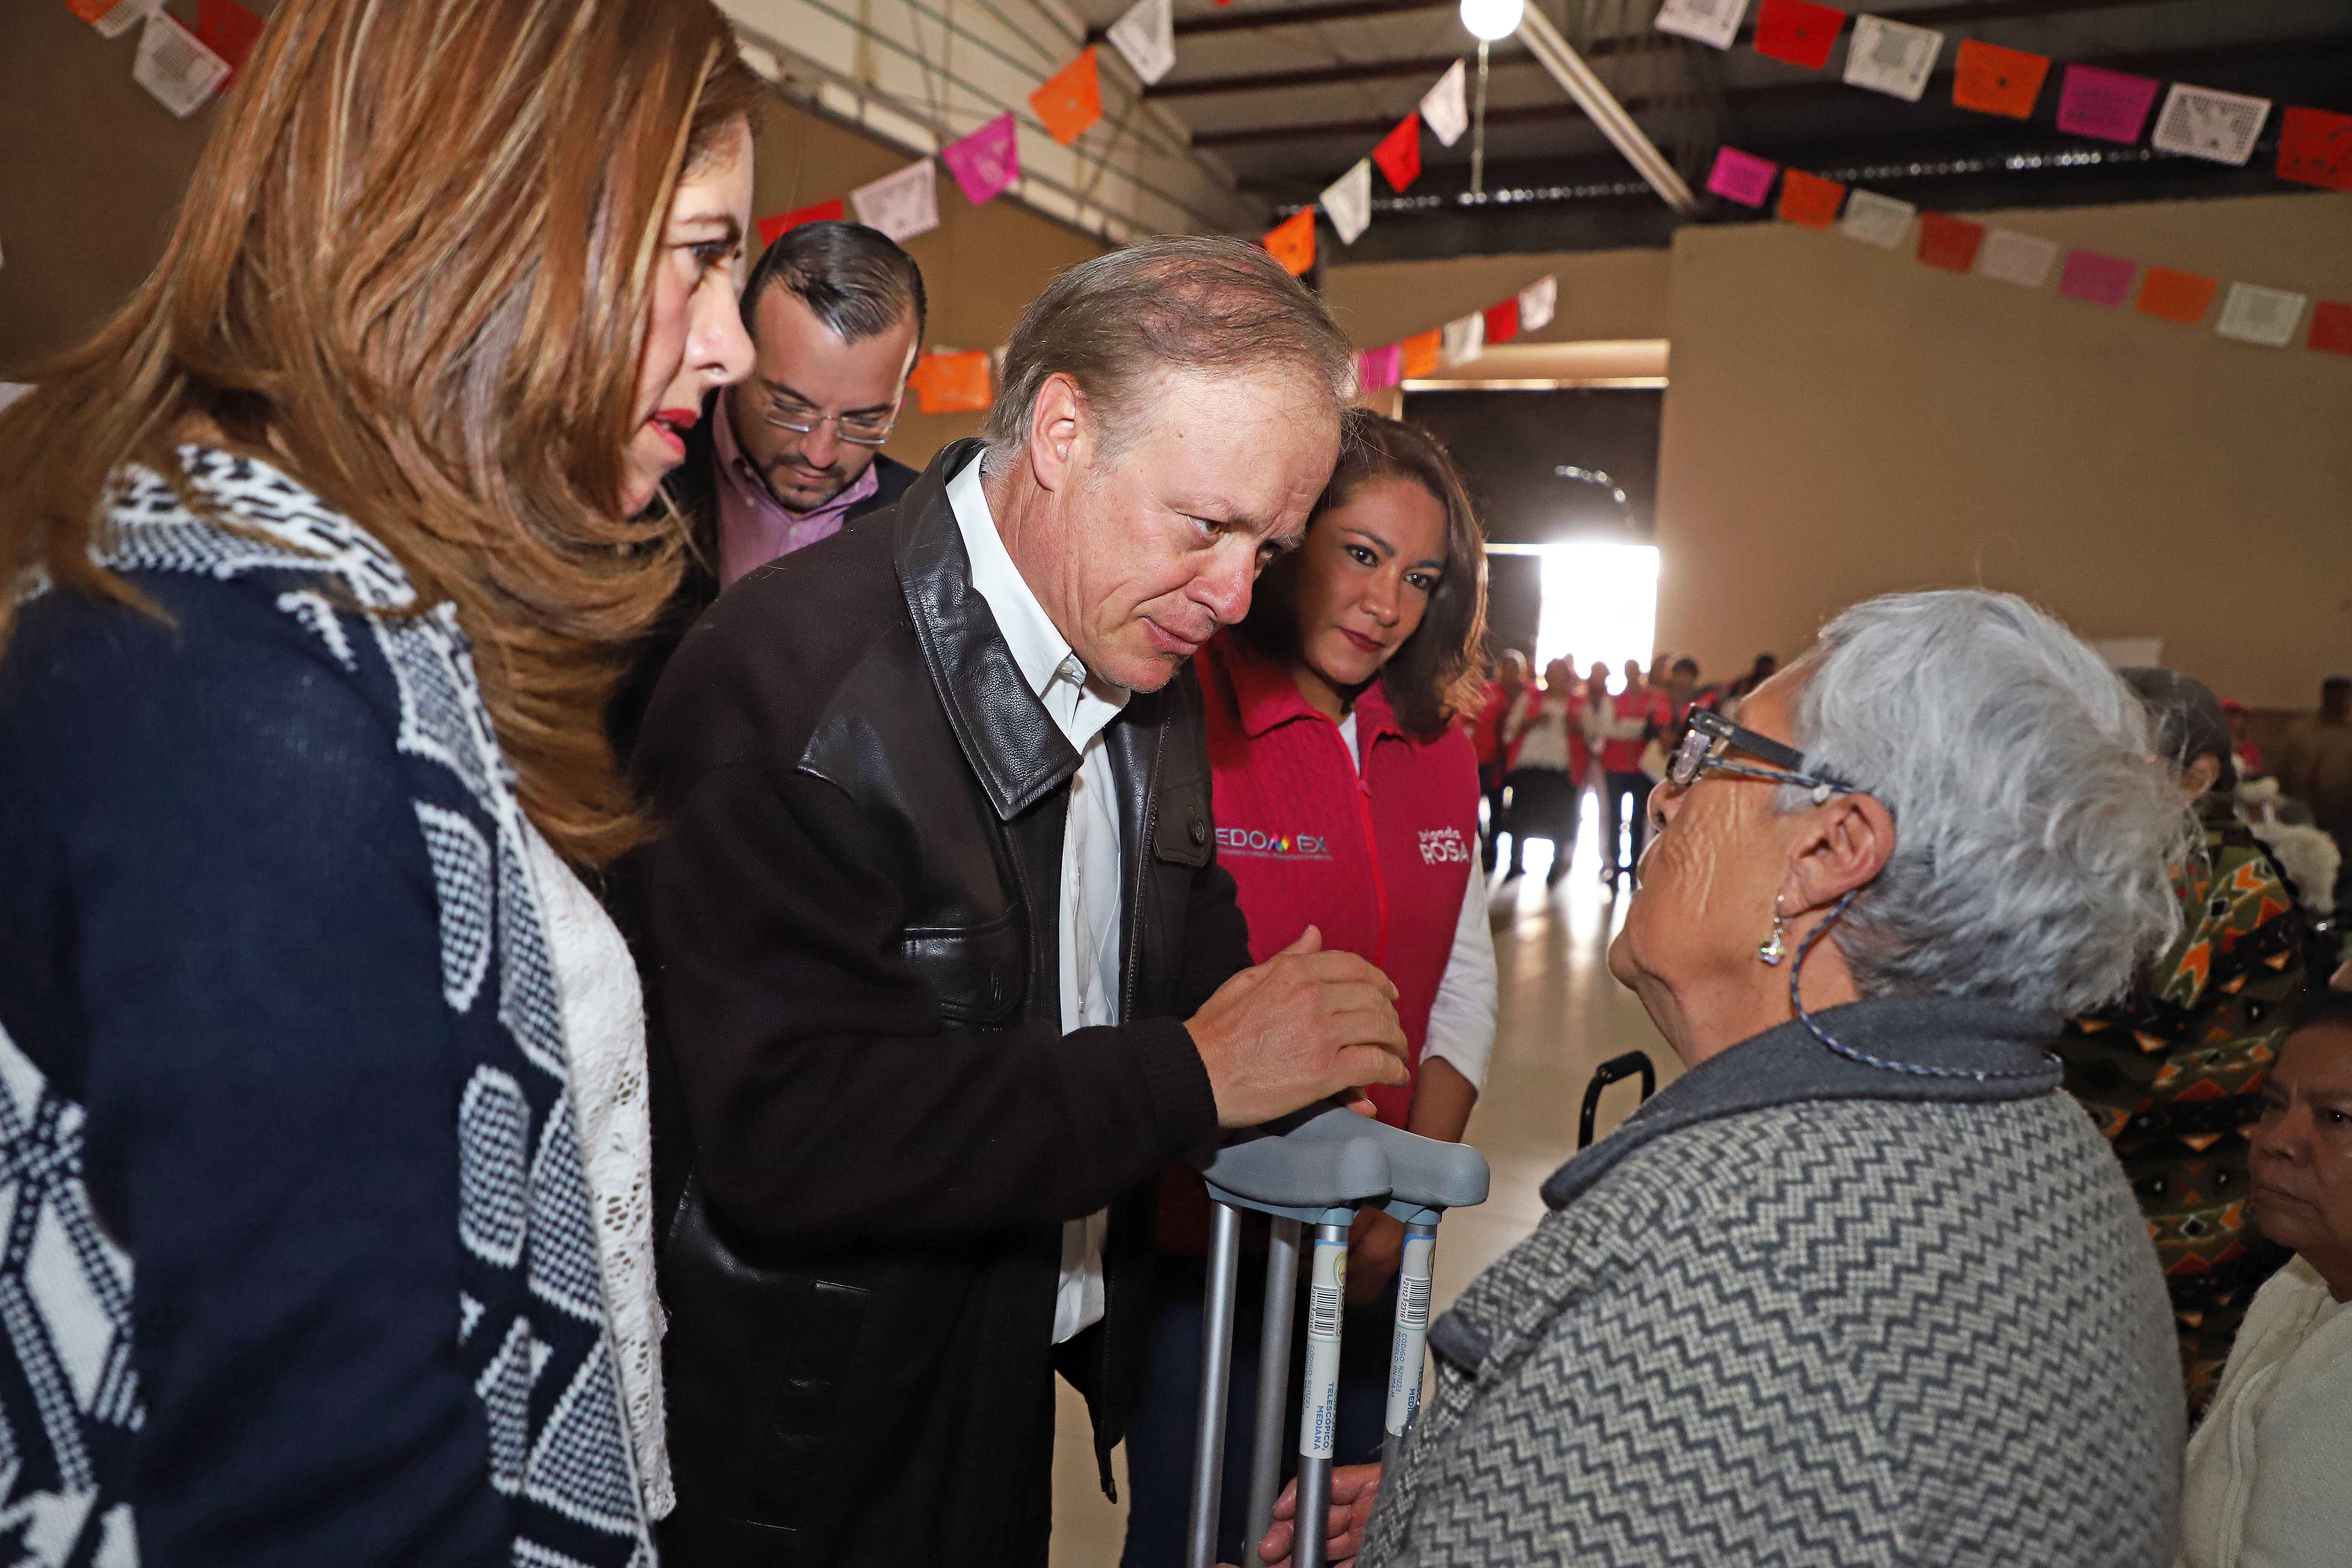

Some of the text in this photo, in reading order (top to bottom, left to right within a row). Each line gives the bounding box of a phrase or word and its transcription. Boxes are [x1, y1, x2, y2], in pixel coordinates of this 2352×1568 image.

[1419, 840, 1469, 865] ROSA
[1314, 1405, 1324, 1450] MEDIANA
[1322, 1382, 1334, 1451] TELESCÓPICO,
